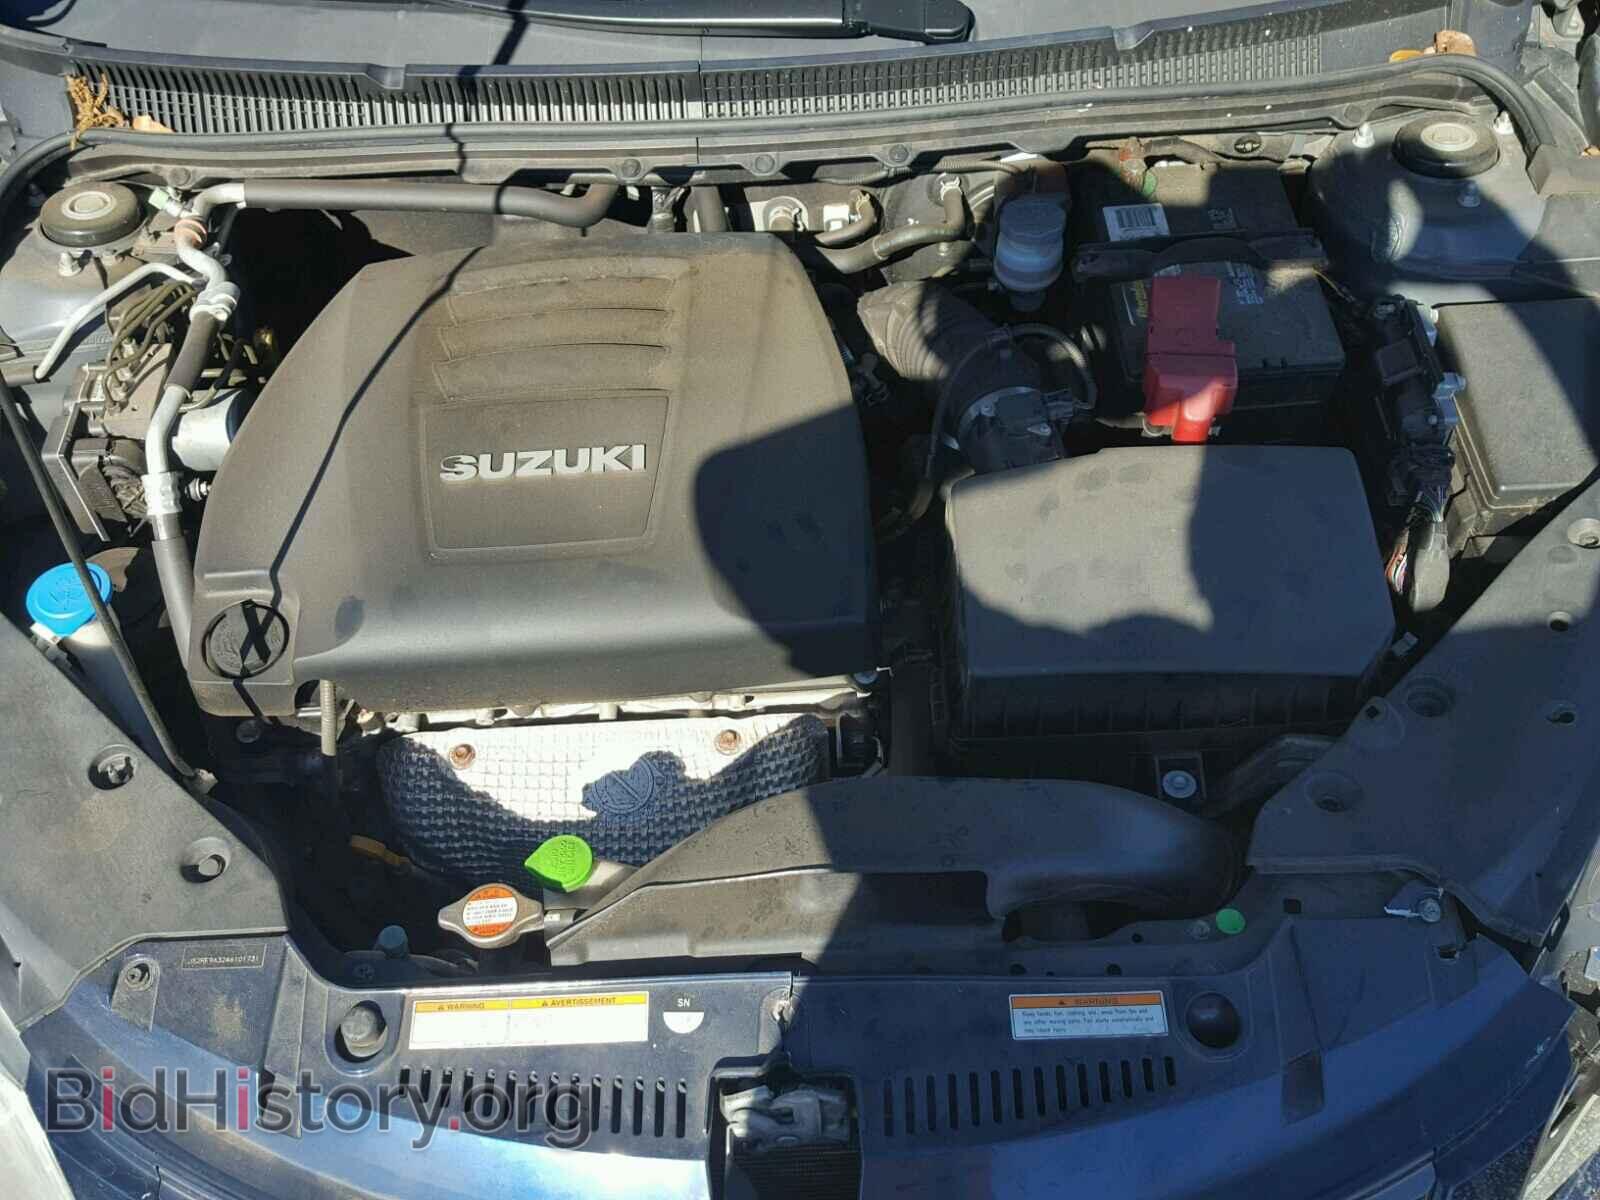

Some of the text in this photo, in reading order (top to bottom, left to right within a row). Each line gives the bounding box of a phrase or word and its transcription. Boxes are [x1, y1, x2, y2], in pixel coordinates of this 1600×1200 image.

[439, 444, 646, 481] SUZUKI
[447, 1002, 485, 1010] WARNING
[550, 997, 617, 1008] AVERTISSEMENT
[677, 998, 690, 1007] SN
